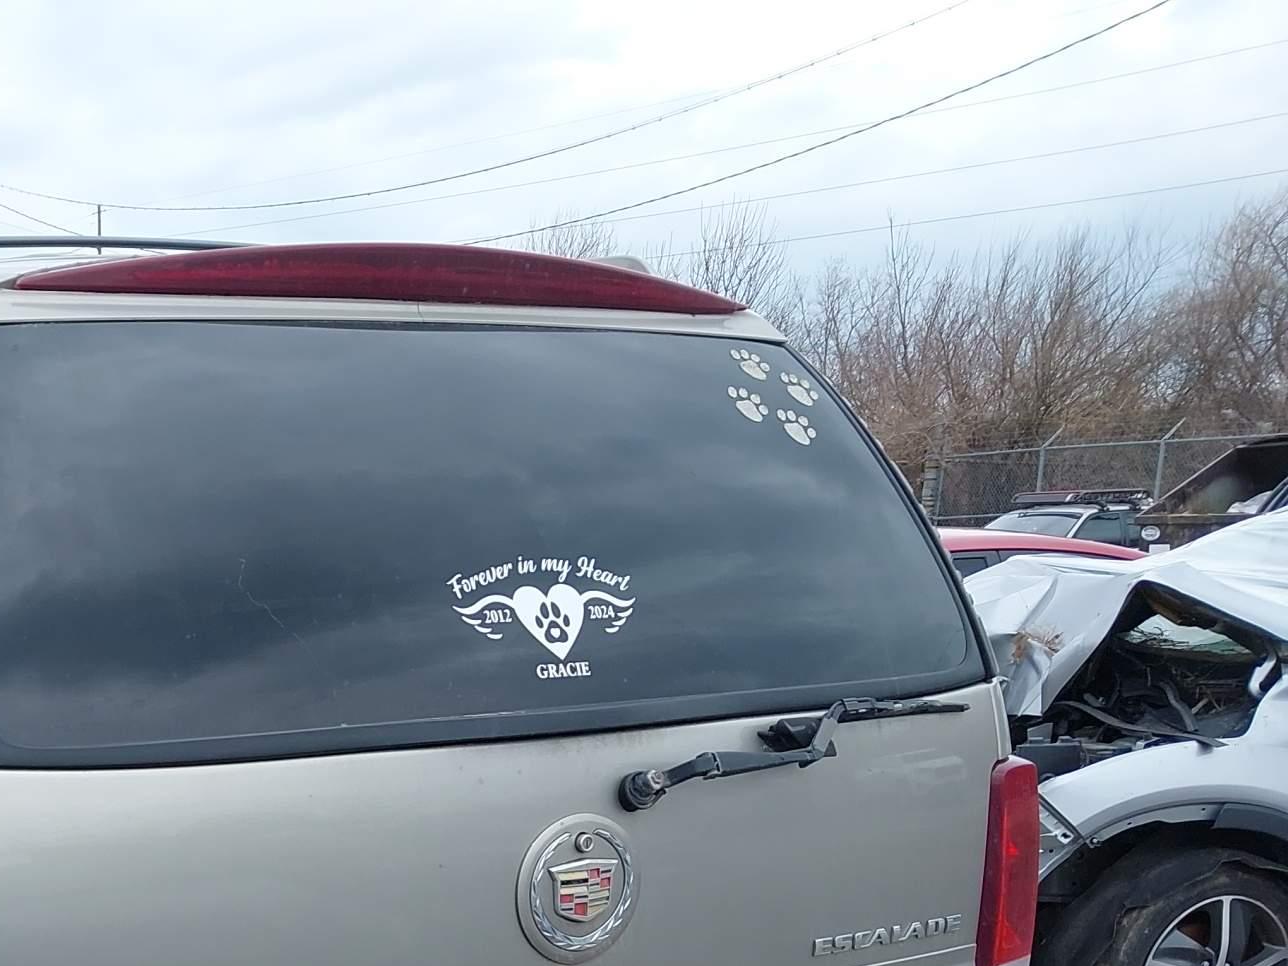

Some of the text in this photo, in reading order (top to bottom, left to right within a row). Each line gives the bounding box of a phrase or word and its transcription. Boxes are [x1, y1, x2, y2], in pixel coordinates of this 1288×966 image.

[446, 556, 632, 600] Forever in my Heart
[482, 608, 513, 624] 2012
[587, 605, 616, 620] 2024
[536, 661, 592, 679] GRACIE
[812, 913, 962, 957] ESCALADE
